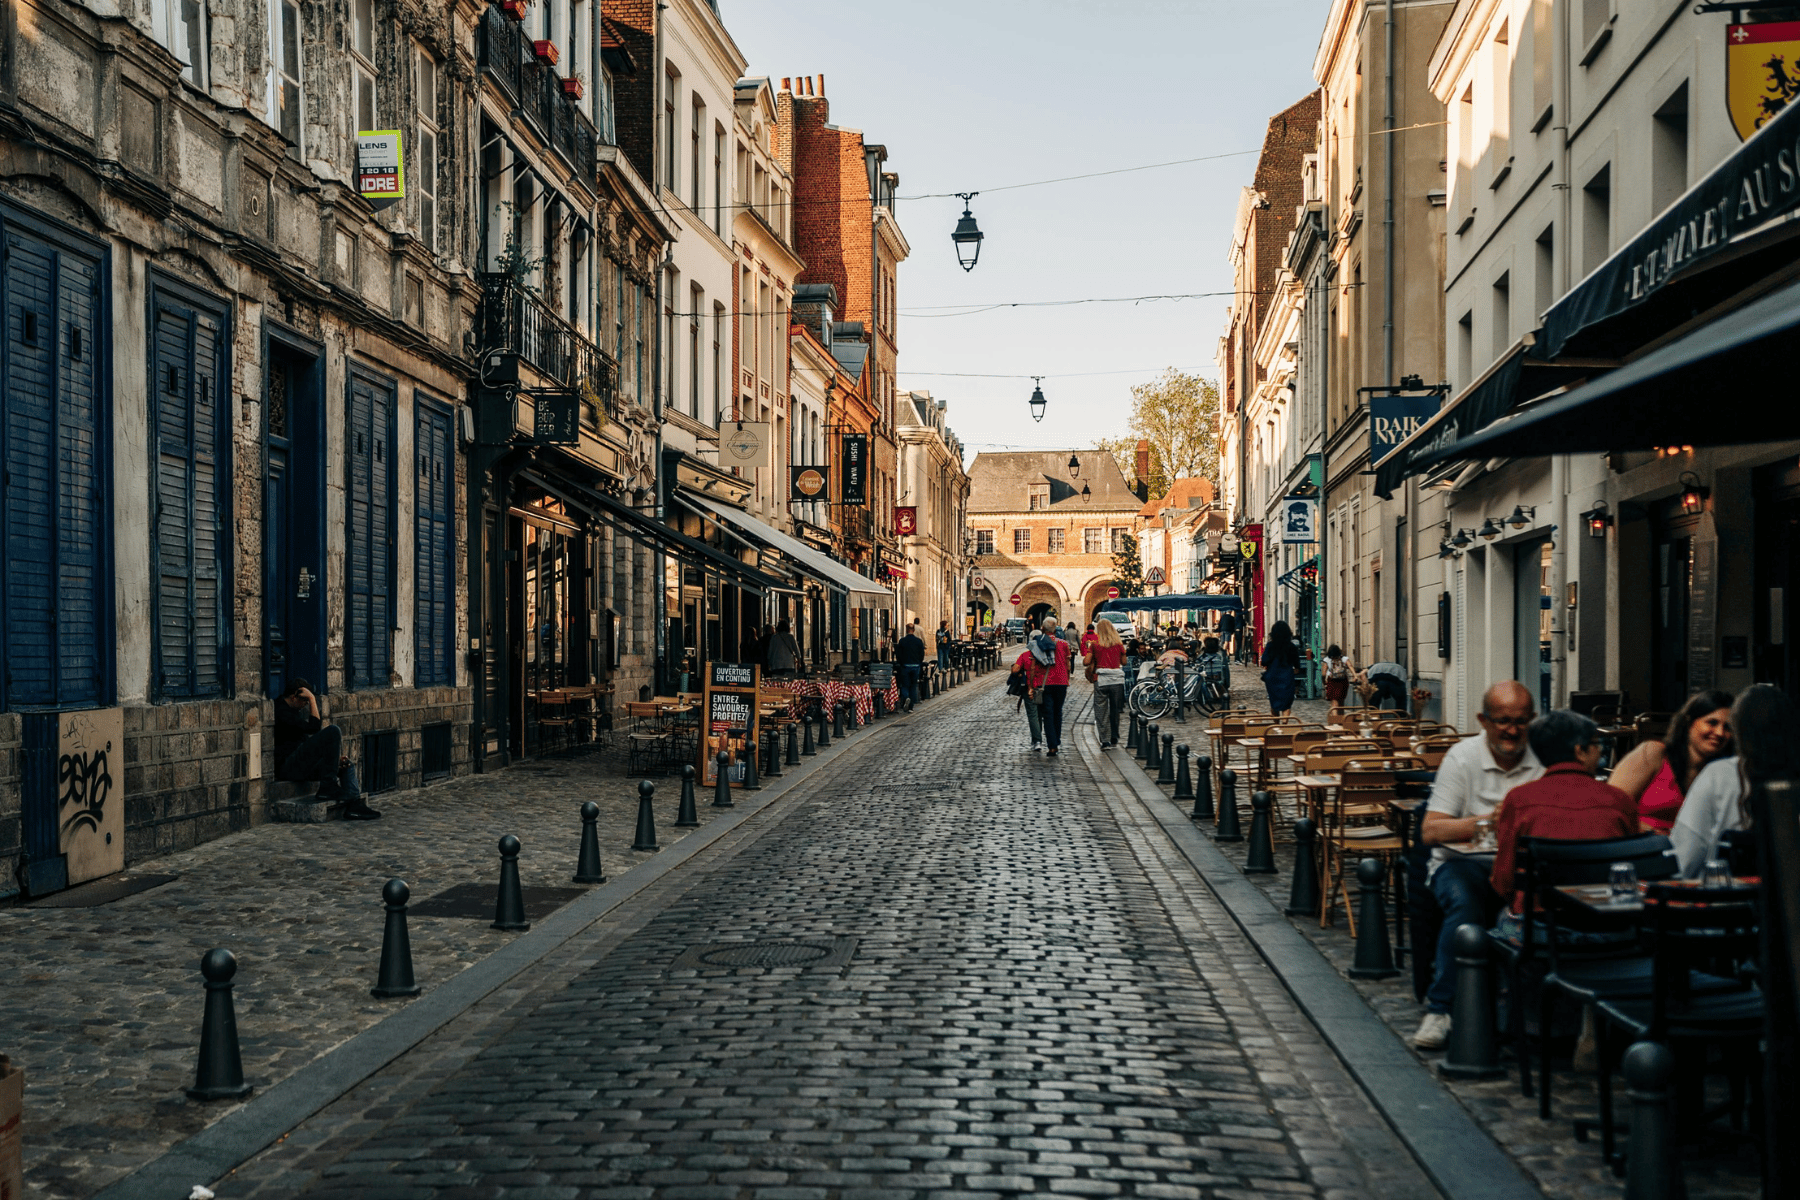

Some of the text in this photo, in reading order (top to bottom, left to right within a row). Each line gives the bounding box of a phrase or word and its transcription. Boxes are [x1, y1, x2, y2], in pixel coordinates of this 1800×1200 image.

[1736, 162, 1775, 221] AU
[1777, 132, 1800, 193] S
[1374, 416, 1432, 432] DAIK
[850, 442, 858, 485] SUSHI WAFU
[716, 668, 751, 676] OUVERTURE
[713, 695, 739, 703] ENTREZ
[712, 704, 749, 712] SAVOUREZ
[712, 712, 745, 720] PROFITEZ
